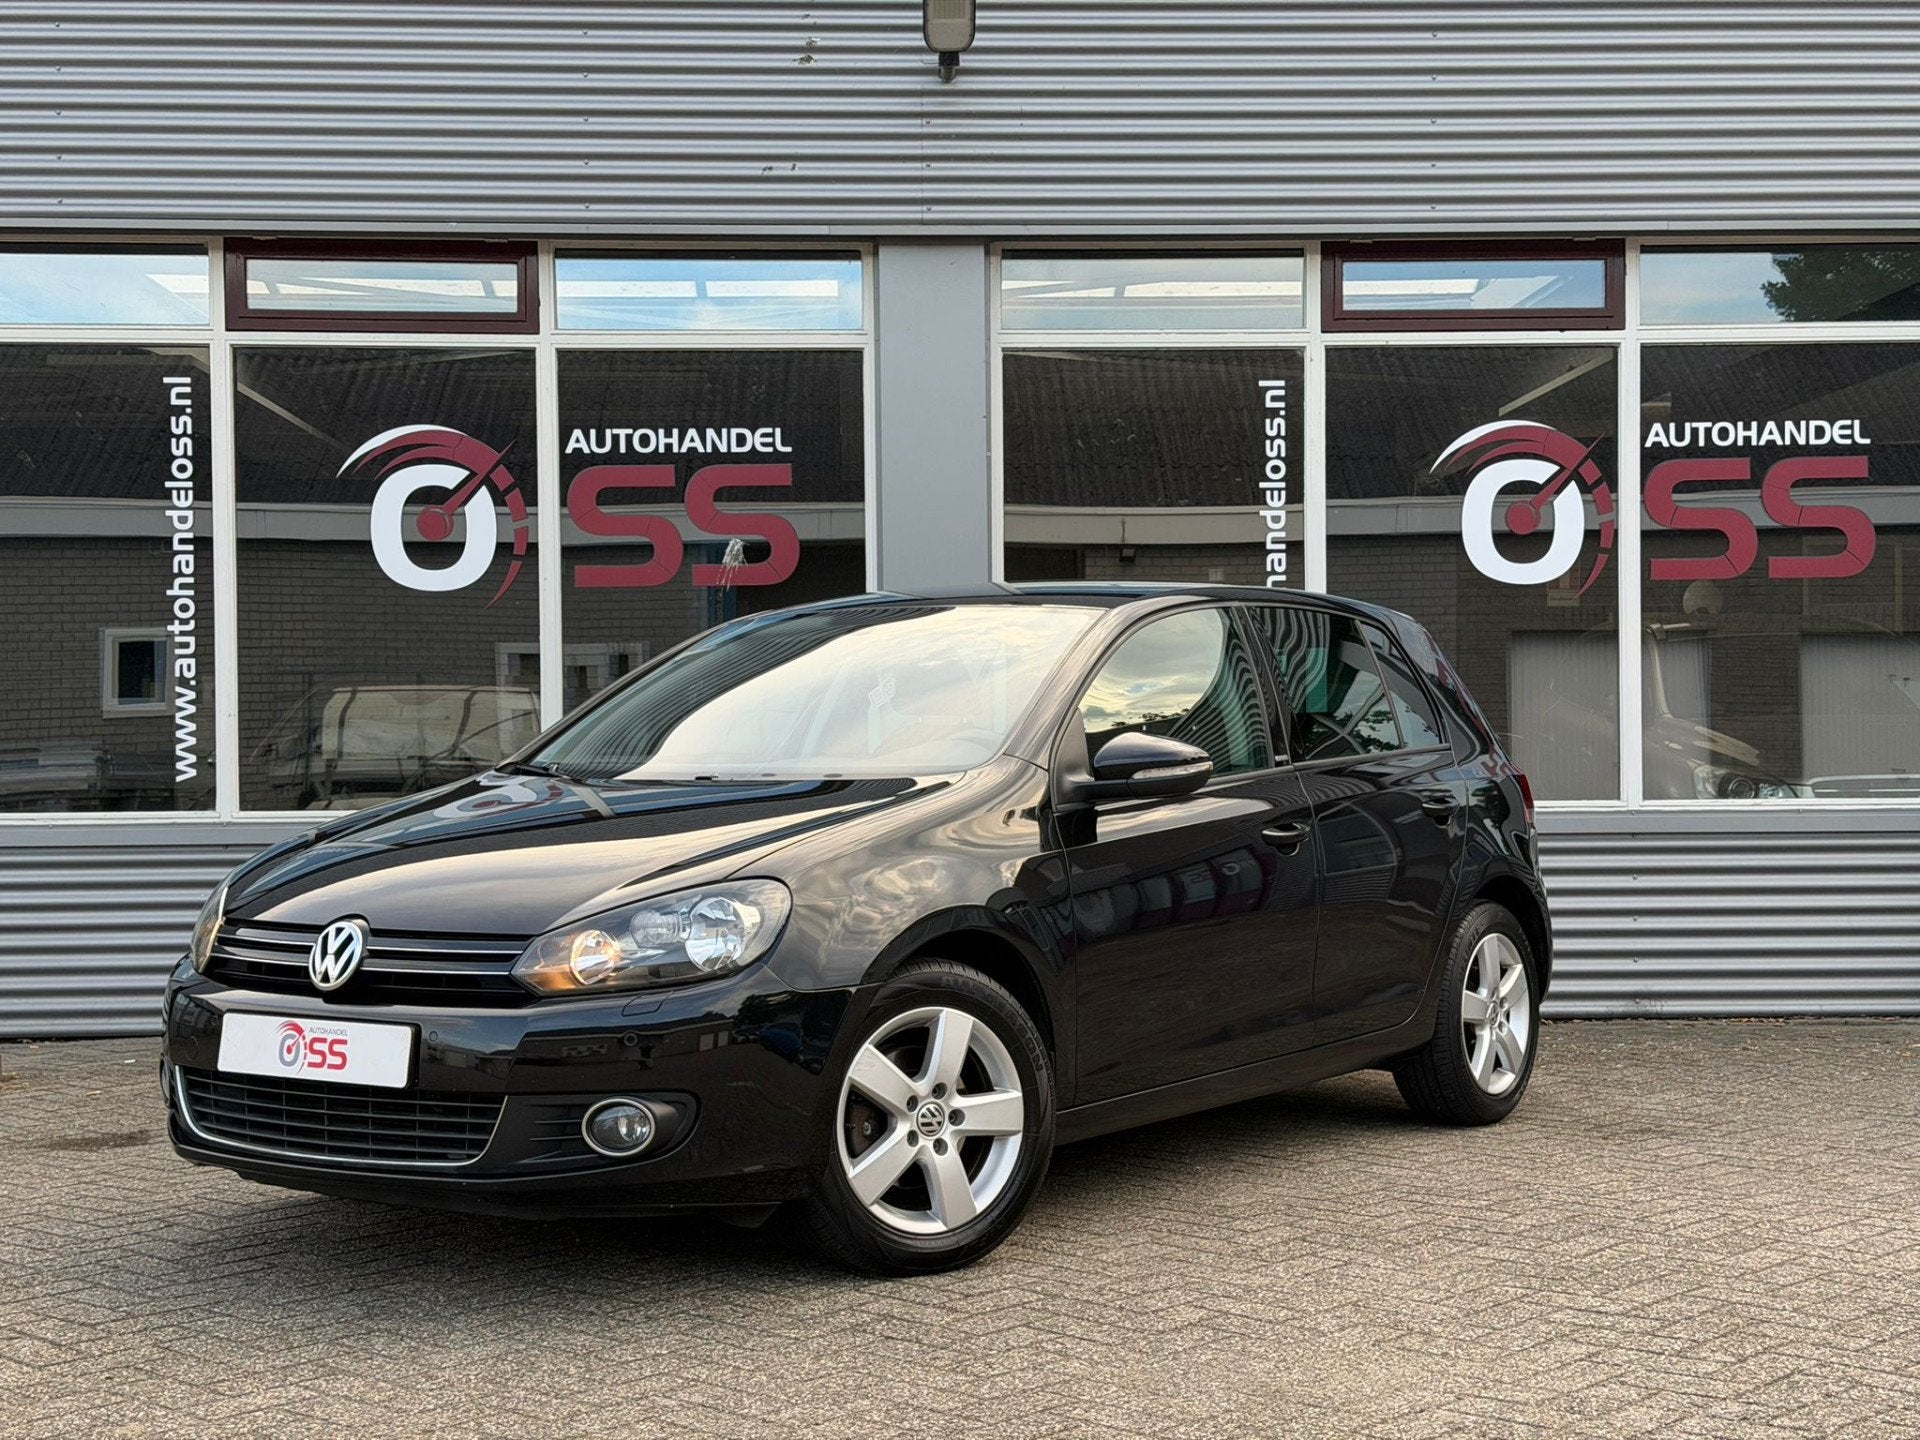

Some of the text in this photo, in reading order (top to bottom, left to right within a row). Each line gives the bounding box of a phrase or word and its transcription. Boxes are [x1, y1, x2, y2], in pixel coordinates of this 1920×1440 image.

[564, 427, 793, 454] AUTOHANDEL
[1644, 419, 1871, 448] AUTOHANDEL
[162, 376, 198, 783] www.autohandeloss.nl
[309, 1026, 349, 1037] AUTOHANDEL
